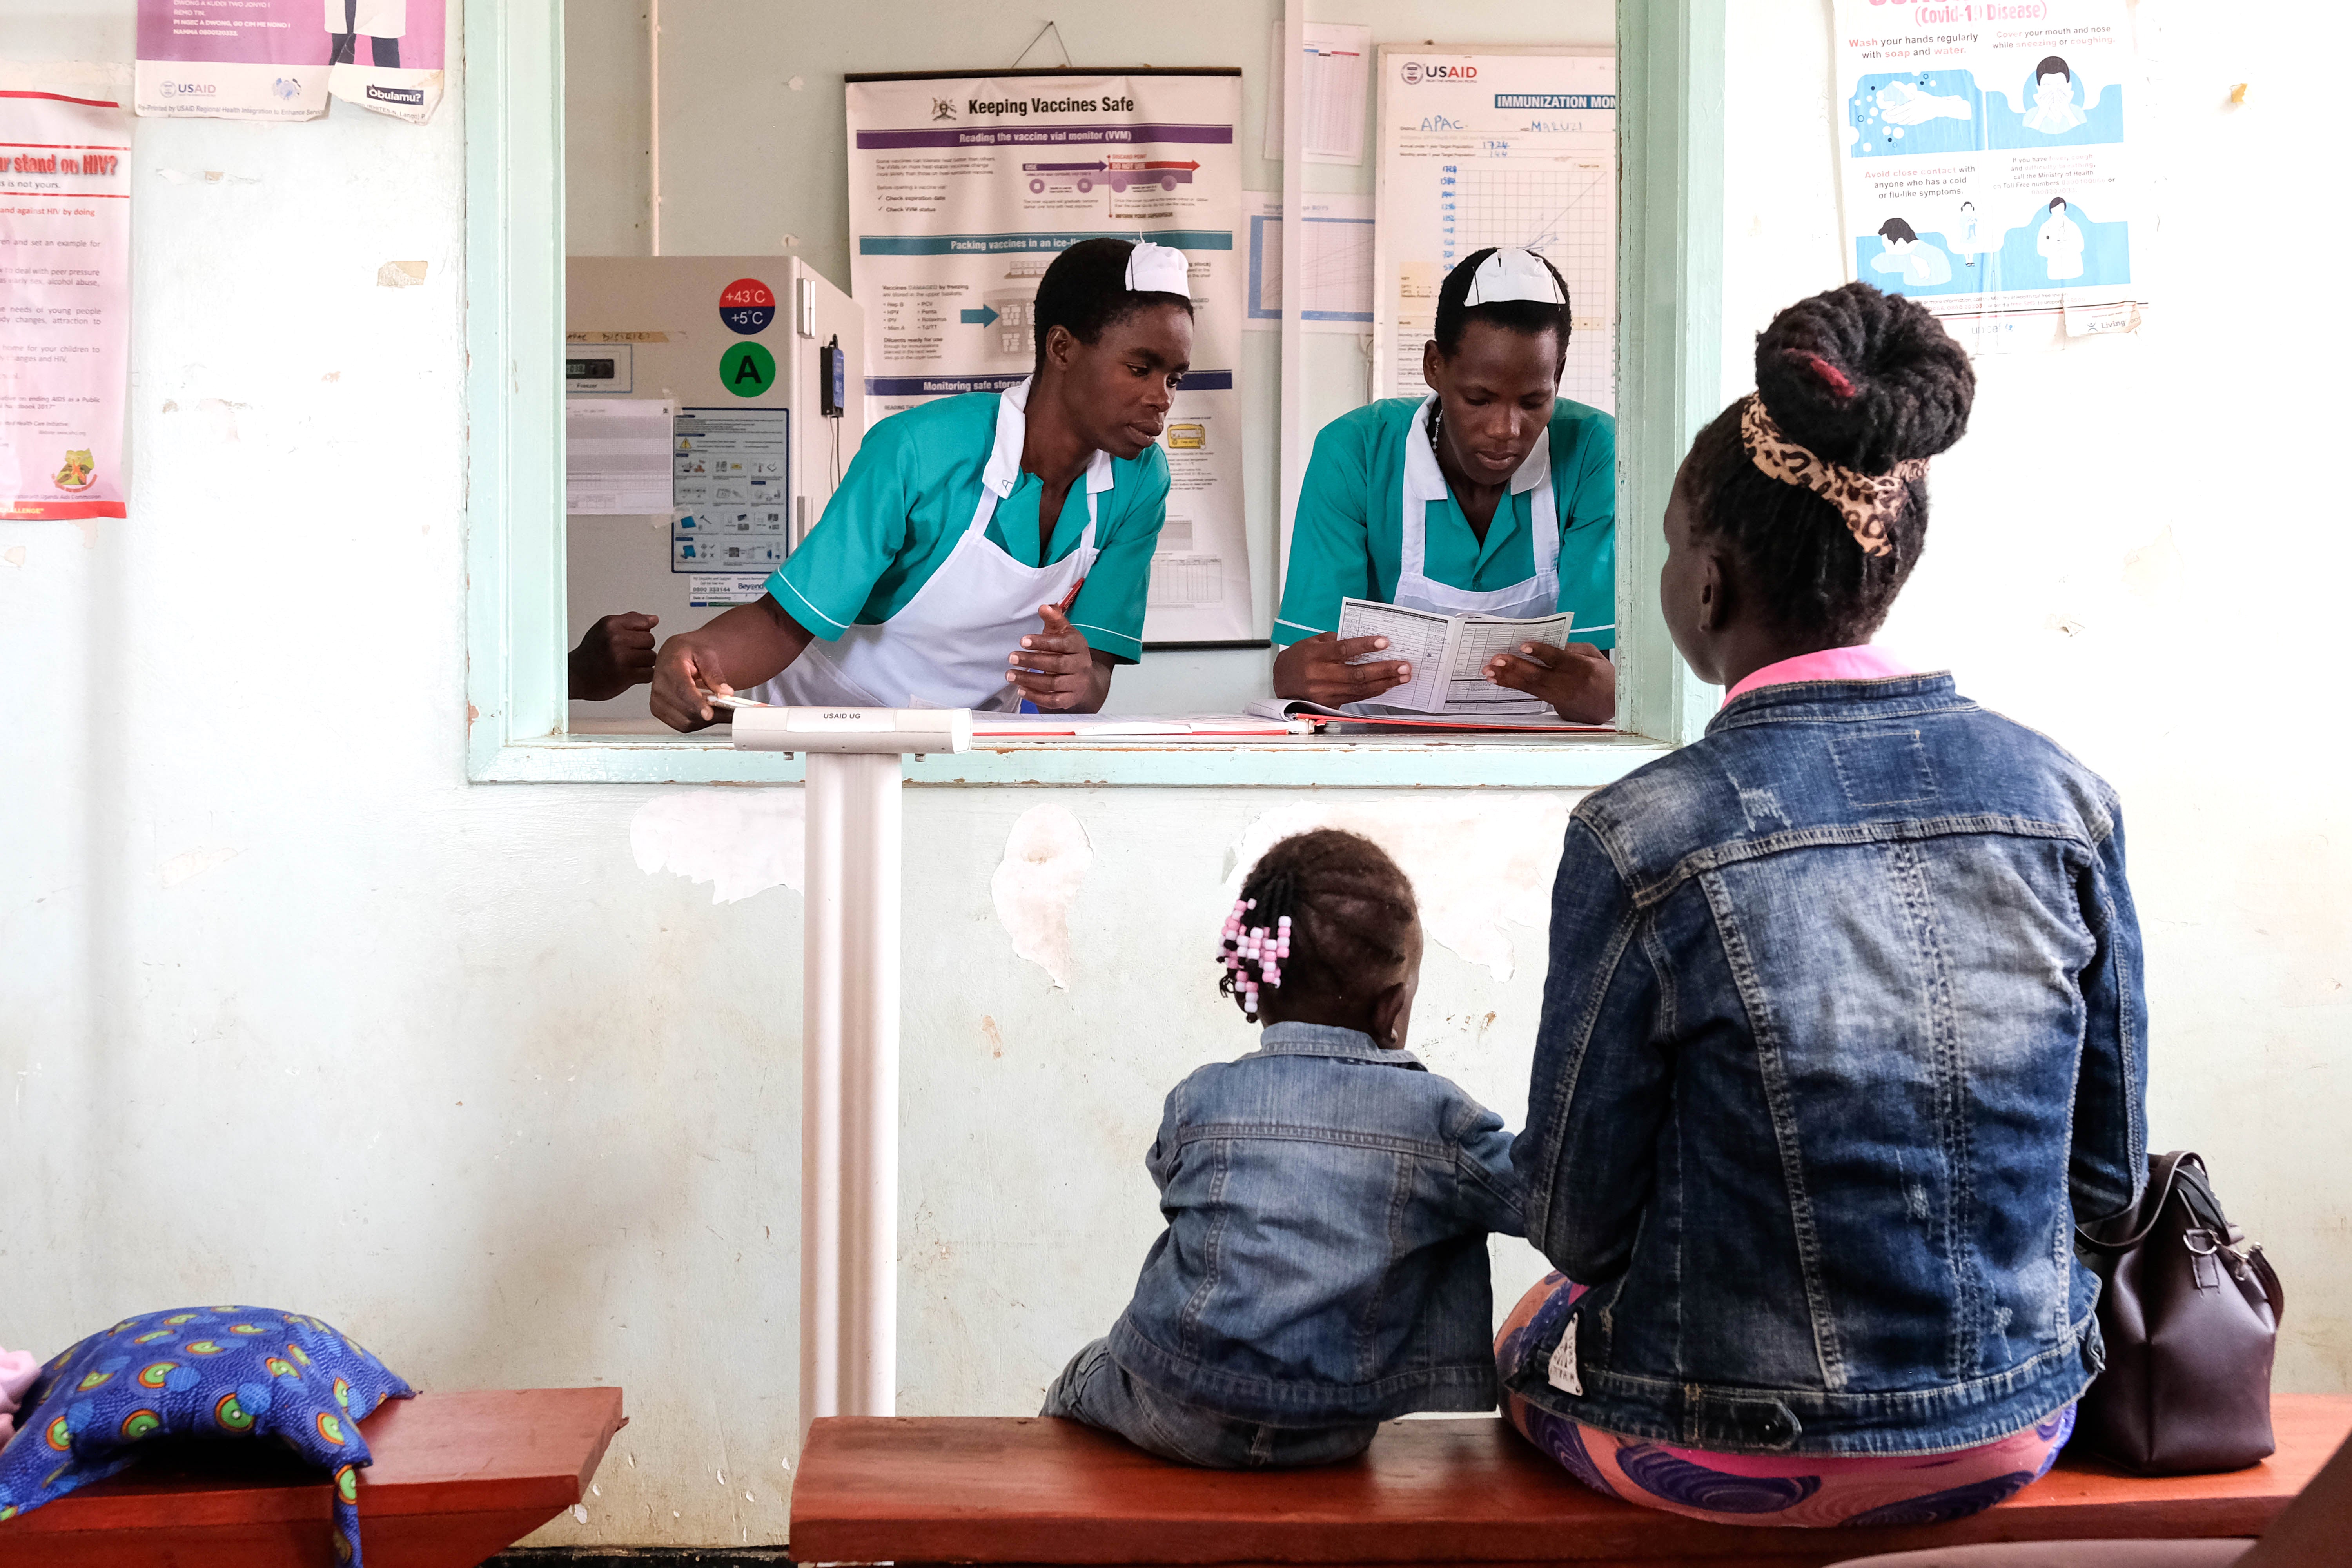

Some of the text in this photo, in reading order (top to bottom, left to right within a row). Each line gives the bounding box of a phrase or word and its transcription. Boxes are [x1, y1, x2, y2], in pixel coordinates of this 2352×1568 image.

[1987, 0, 2047, 21] Disease)
[1849, 33, 1978, 47] Wash your hands regularly
[2024, 30, 2043, 38] your
[2016, 39, 2057, 47] sneezing
[2070, 36, 2116, 45] coughing.
[1862, 47, 1967, 59] with soap and water.
[1426, 65, 1477, 78] USAID
[178, 84, 216, 94] USAID
[368, 88, 421, 102] Obulamu?
[969, 96, 1134, 116] Keeping Vaccines Safe
[1497, 96, 1586, 108] IMMUNIZATION
[1421, 115, 1464, 132] APAC
[959, 130, 1132, 144] Reading the vaccine vial monitor (VVM)
[14, 153, 118, 175] stand on HIV?
[1864, 170, 1891, 179] Avoid
[1920, 167, 1956, 176] contact
[1874, 180, 1904, 190] anyone
[1949, 176, 1967, 185] cold
[1889, 190, 1916, 198] flu-like
[1919, 188, 1964, 198] symptoms.
[18, 207, 45, 215] against
[63, 208, 72, 217] by
[74, 209, 95, 217] doing
[951, 240, 987, 251] Packing
[988, 239, 1026, 249] vaccines
[1028, 238, 1037, 248] in
[1040, 240, 1051, 248] an
[725, 289, 766, 303] +43°C
[731, 310, 764, 325] +5°C
[2101, 321, 2125, 329] Living
[734, 355, 762, 384] A
[923, 381, 972, 392] Monitoring
[973, 380, 992, 390] safe
